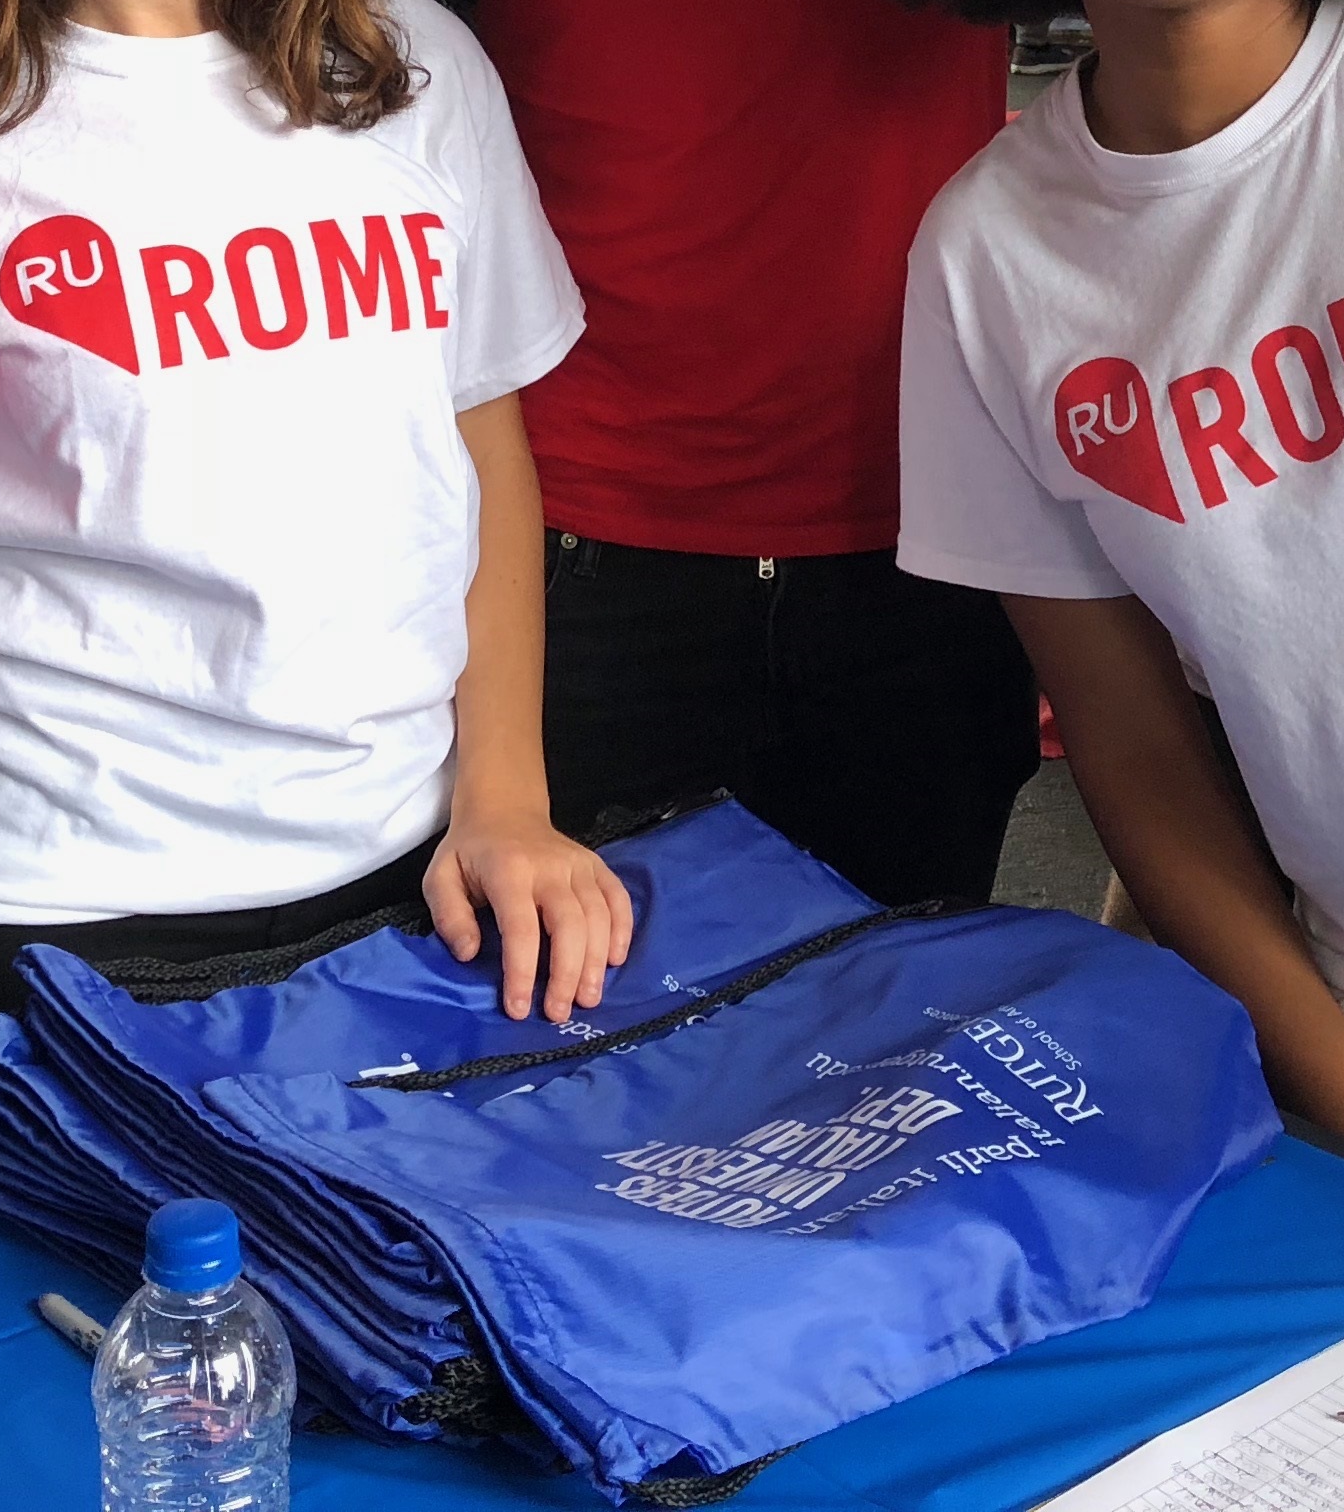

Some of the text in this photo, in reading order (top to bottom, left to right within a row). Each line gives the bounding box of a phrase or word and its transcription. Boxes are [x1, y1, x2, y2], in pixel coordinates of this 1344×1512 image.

[14, 212, 450, 369] RU ROME
[1065, 380, 1140, 456] RU
[1015, 1016, 1038, 1031] of
[1032, 1029, 1082, 1072] School
[947, 1014, 1104, 1125] RUTGE
[730, 1118, 908, 1172] ITALIAN
[936, 1134, 1041, 1176] parli
[594, 1173, 791, 1229] RUTGERS
